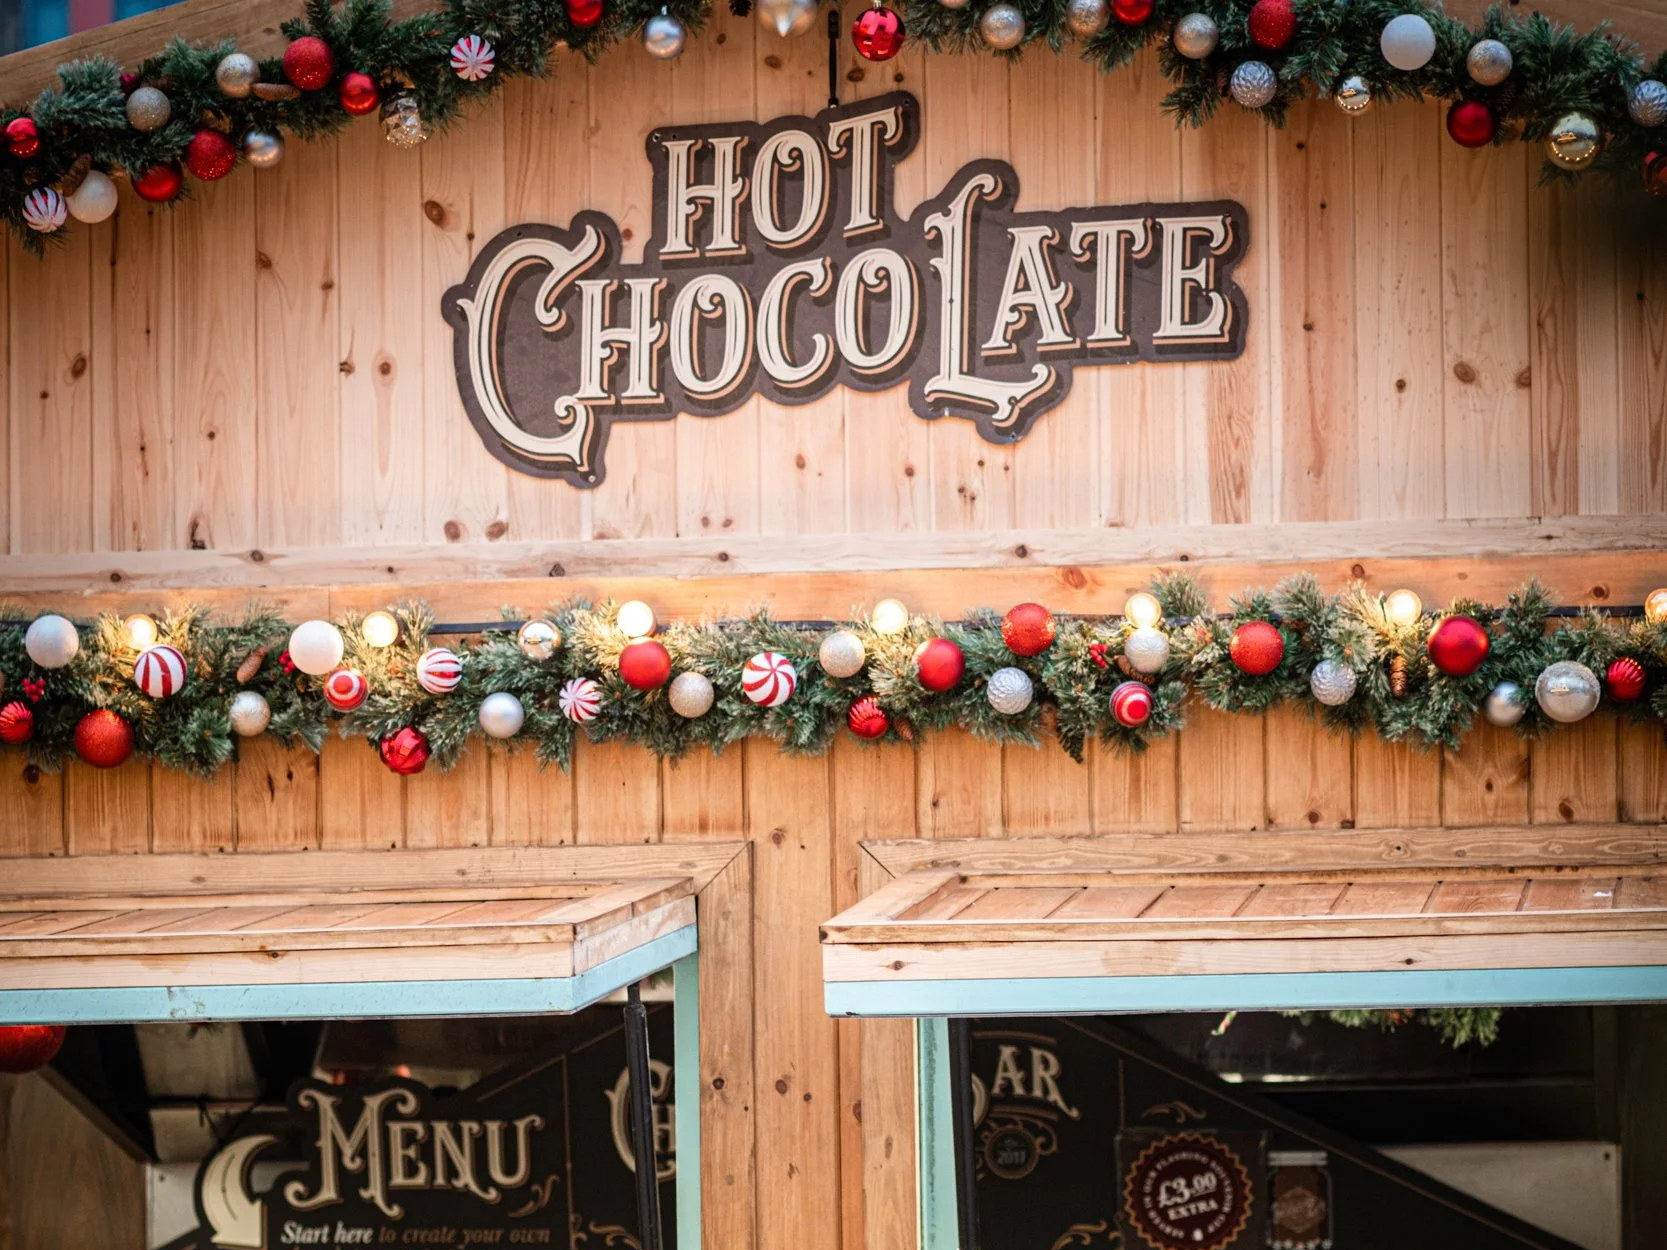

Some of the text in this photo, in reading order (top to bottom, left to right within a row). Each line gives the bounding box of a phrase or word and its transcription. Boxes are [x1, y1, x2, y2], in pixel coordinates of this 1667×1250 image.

[659, 106, 908, 260] HOT
[456, 171, 1237, 471] CHOCOLATE
[284, 1088, 545, 1220] MENU
[1159, 1172, 1218, 1208] £3.00
[280, 1220, 329, 1244] Start
[334, 1220, 374, 1244] here
[379, 1226, 396, 1243] to
[403, 1226, 456, 1243] create
[462, 1228, 504, 1249] your
[1166, 1197, 1219, 1221] EXTRA
